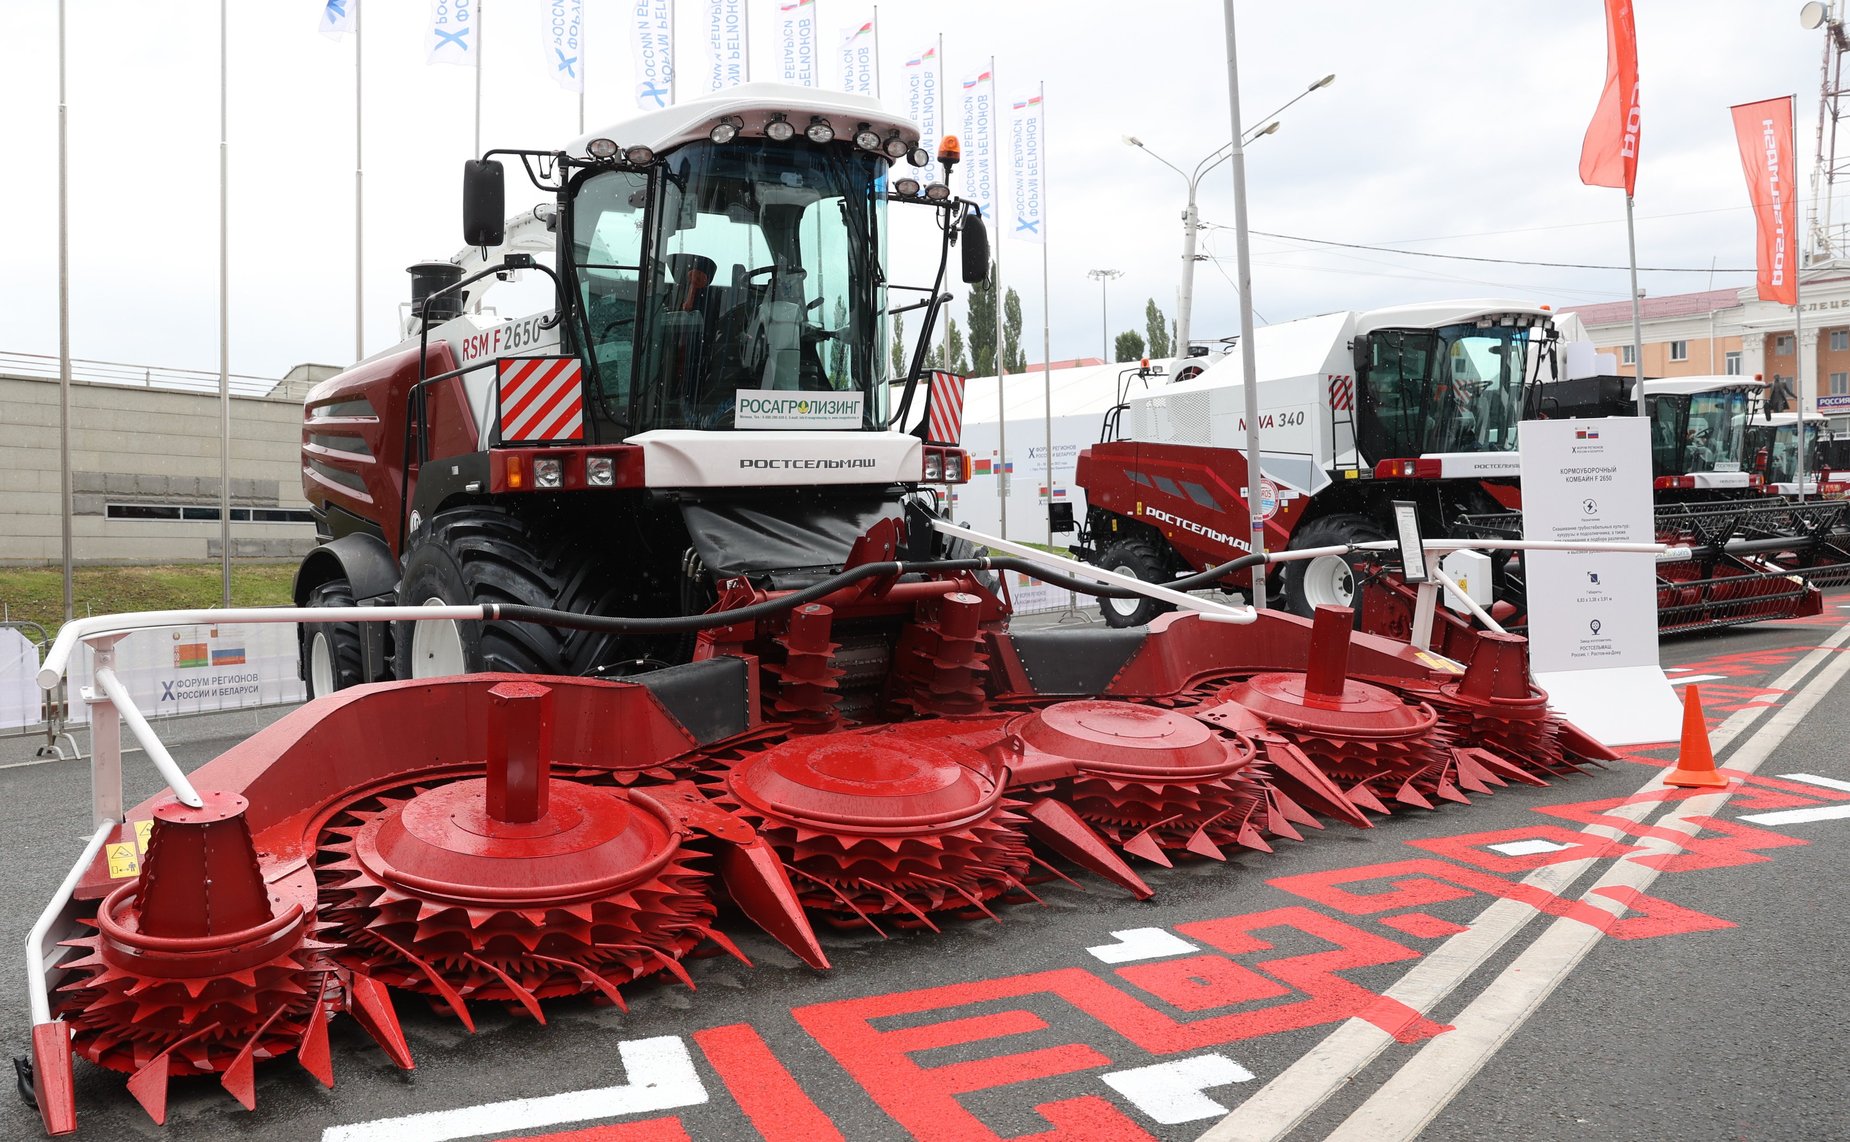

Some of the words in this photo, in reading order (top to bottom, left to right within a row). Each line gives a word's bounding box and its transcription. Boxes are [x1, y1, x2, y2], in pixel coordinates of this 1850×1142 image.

[462, 332, 490, 362] RSM
[493, 329, 501, 353] F
[503, 318, 541, 351] 2650
[740, 399, 860, 414] РОСАГРОЛИЗИНГ
[1238, 414, 1275, 431] NVA
[1278, 411, 1305, 427] 340
[740, 458, 877, 469] РОСТСЕЛЬМАШ
[1560, 466, 1617, 475] КОРМОУБОРОЧНЫЙ
[1566, 475, 1594, 483] КОМБАЙН
[177, 677, 210, 688] ФОРУМ
[211, 673, 259, 686] РЕГИОНОВ
[161, 680, 176, 702] X
[177, 690, 210, 700] РОССИИ
[211, 688, 218, 697] И
[220, 685, 259, 696] БЕЛАРУСИ
